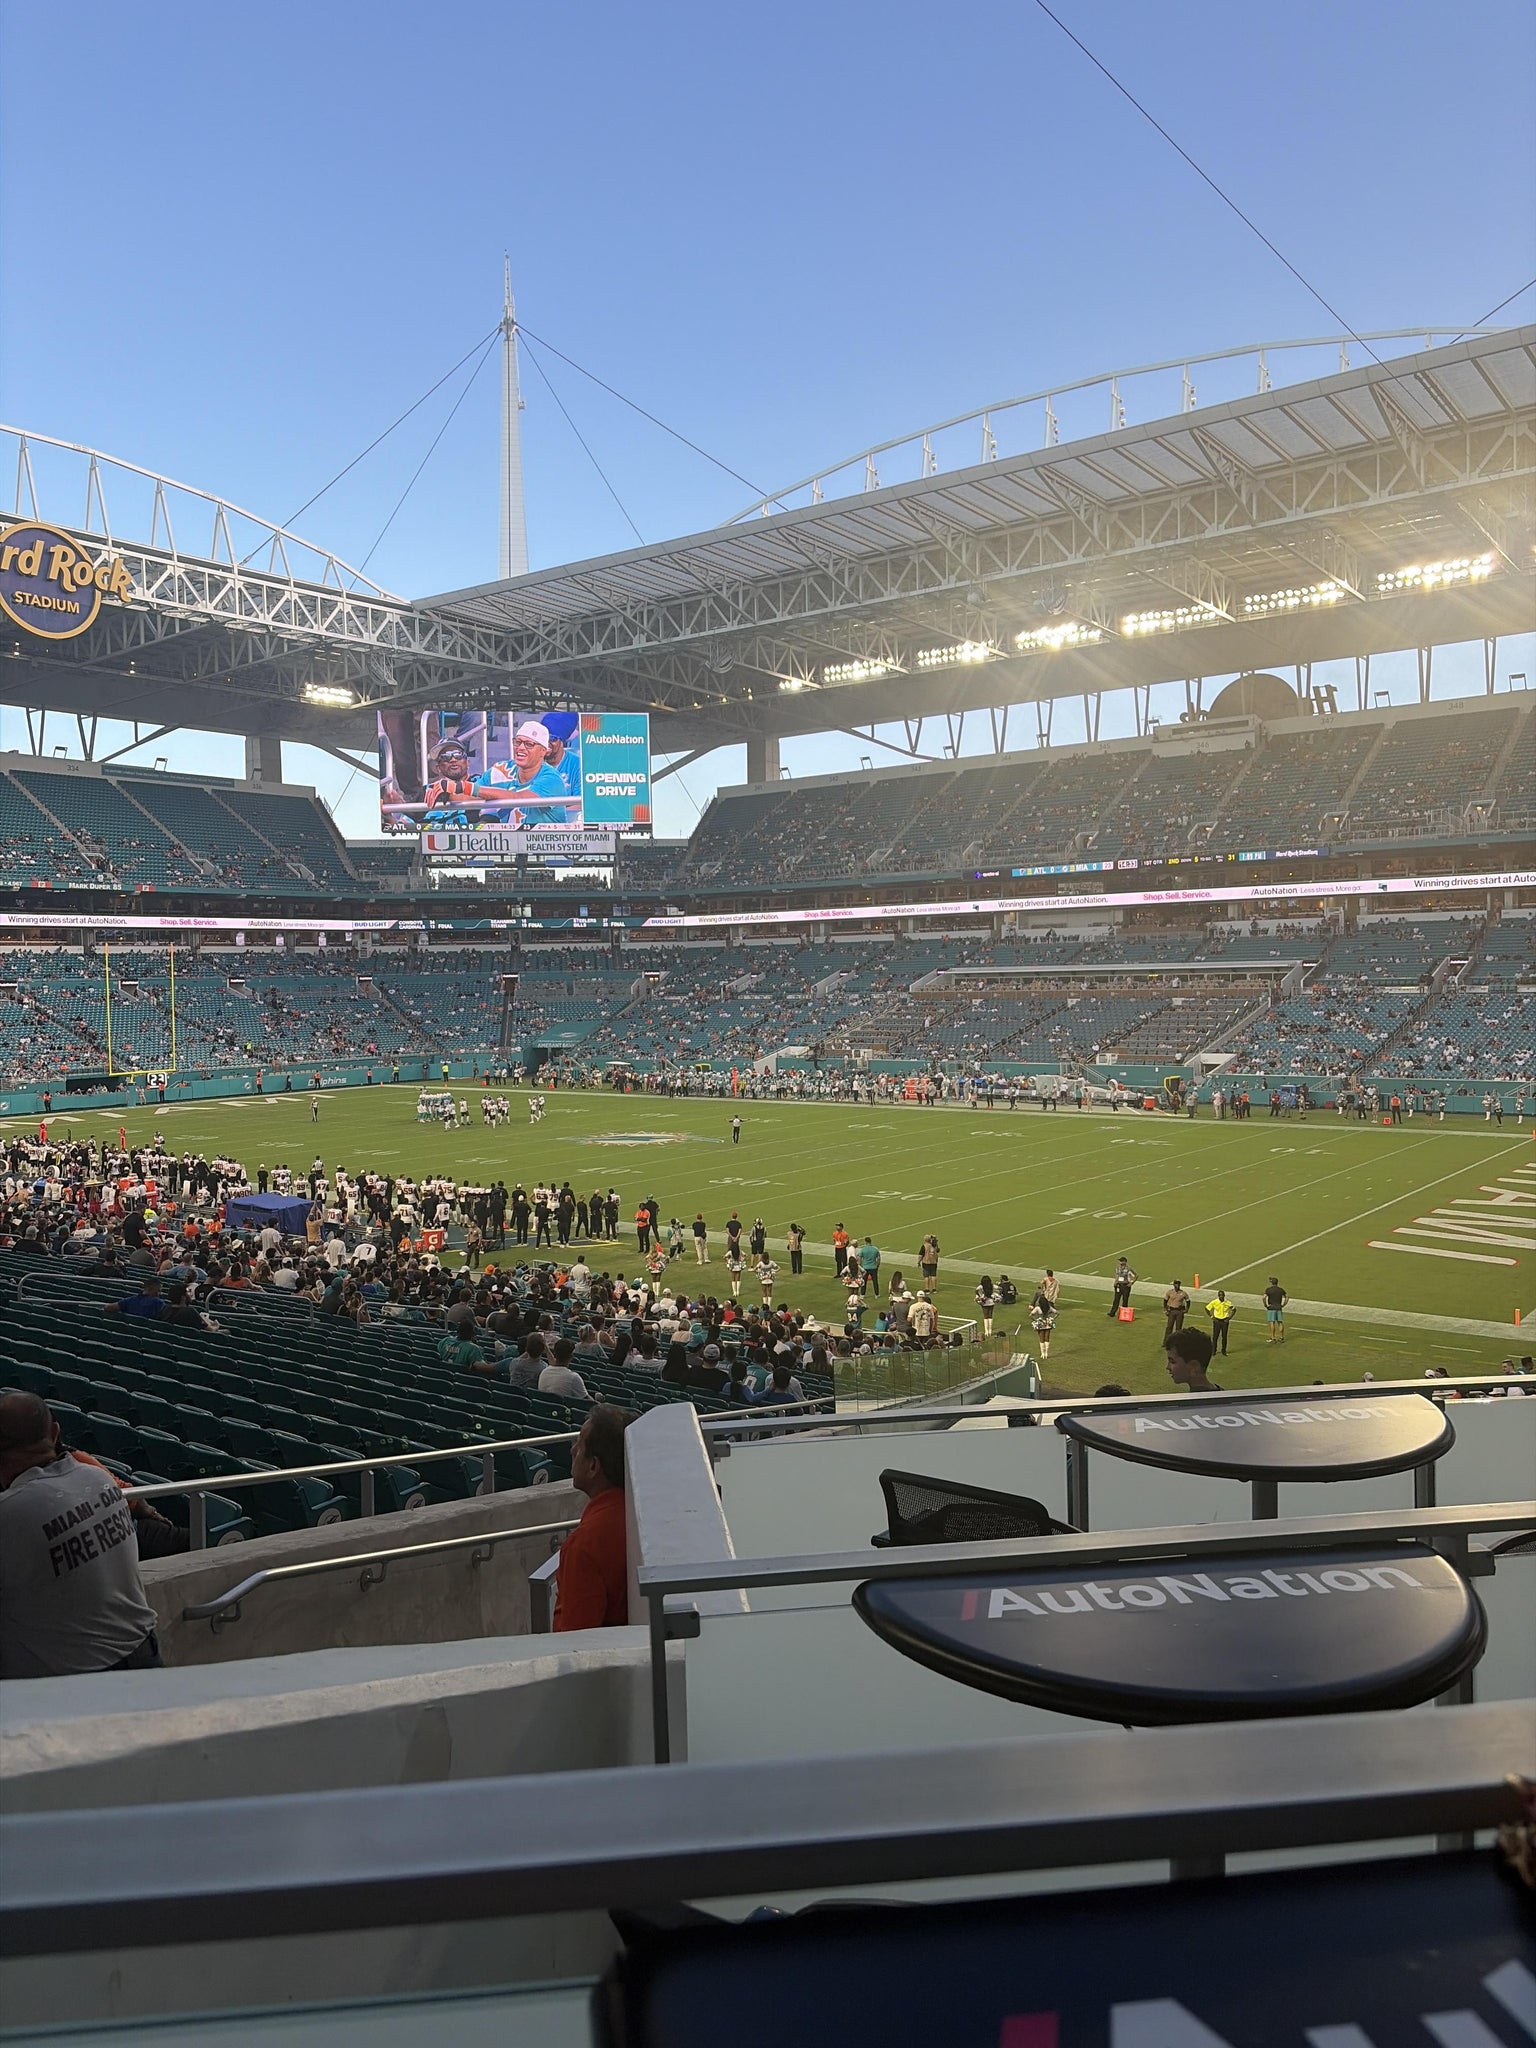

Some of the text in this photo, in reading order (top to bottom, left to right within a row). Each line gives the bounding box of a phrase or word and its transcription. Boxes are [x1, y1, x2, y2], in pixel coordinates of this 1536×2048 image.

[48, 544, 132, 602] Rock
[14, 590, 80, 615] STADIUM
[585, 773, 646, 783] OPENING
[596, 785, 636, 796] DRIVE
[526, 834, 610, 842] UNIVERSITY OF MIAMI
[526, 843, 588, 852] HEALTH SYSTEM
[1034, 867, 1046, 875] ATL
[1076, 864, 1089, 872] MIA
[90, 882, 110, 890] DUPER
[1414, 879, 1450, 888] Winning
[1451, 877, 1478, 886] drives
[1480, 876, 1500, 884] start
[1514, 874, 1536, 883] Auto
[1143, 893, 1164, 901] Shop.
[1181, 890, 1212, 899] Service.
[8, 915, 38, 925] Winning
[39, 916, 61, 924] drives
[62, 916, 78, 924] start
[88, 917, 127, 925] AutoNation.
[160, 918, 178, 926] Shop.
[150, 1073, 164, 1086] 23
[307, 1076, 347, 1087] Dlphins
[1056, 1206, 1128, 1219] 10
[429, 1234, 438, 1244] G
[366, 1246, 372, 1256] 7
[42, 1501, 94, 1541] MIAMI
[100, 1486, 123, 1508] DAD
[49, 1505, 135, 1578] FIRE RESCU
